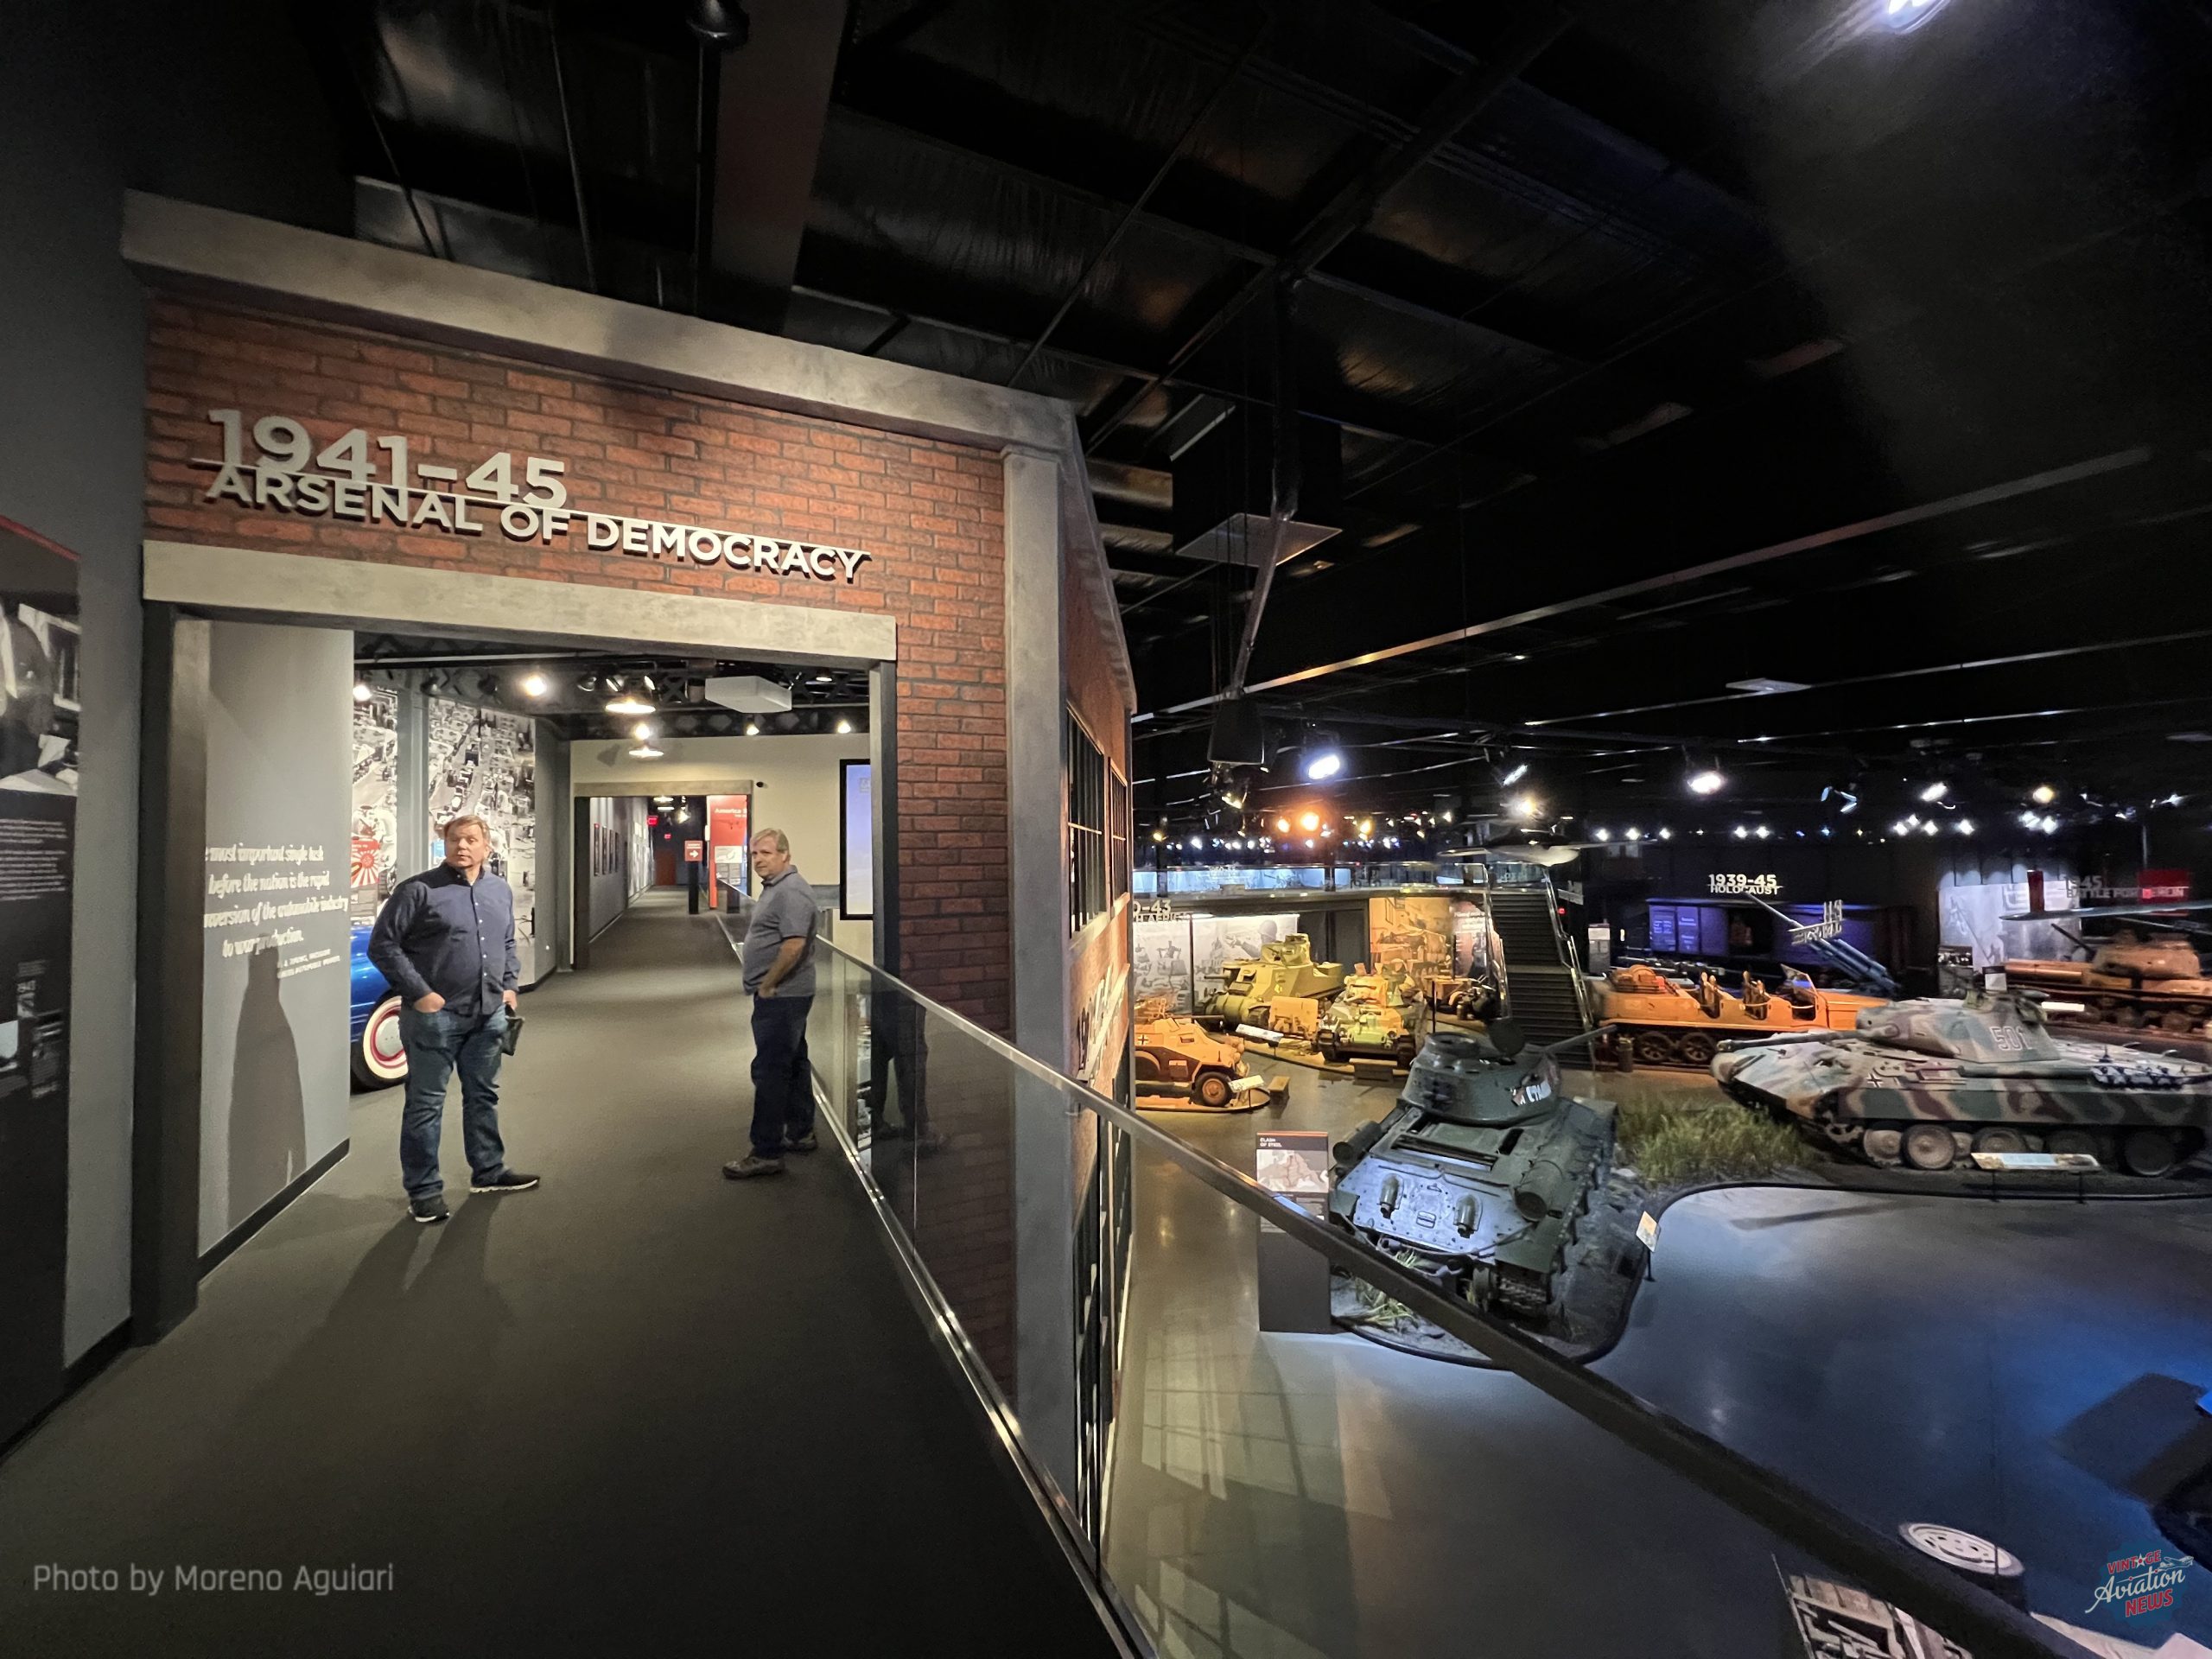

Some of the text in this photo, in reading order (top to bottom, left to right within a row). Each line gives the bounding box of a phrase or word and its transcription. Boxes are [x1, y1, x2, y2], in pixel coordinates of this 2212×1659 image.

[208, 409, 567, 508] 1941-45
[207, 464, 867, 581] ARSENAL OF DEMOCRACY
[208, 873, 241, 899] before
[243, 873, 258, 893] the
[260, 872, 289, 890] nation
[289, 872, 297, 889] is
[297, 872, 309, 888] the
[1708, 874, 1777, 887] 1939-45
[1710, 885, 1780, 895] HOLOCAUST
[251, 901, 263, 926] of
[263, 901, 276, 920] the
[222, 939, 234, 958] to
[1989, 1026, 2032, 1051] 501
